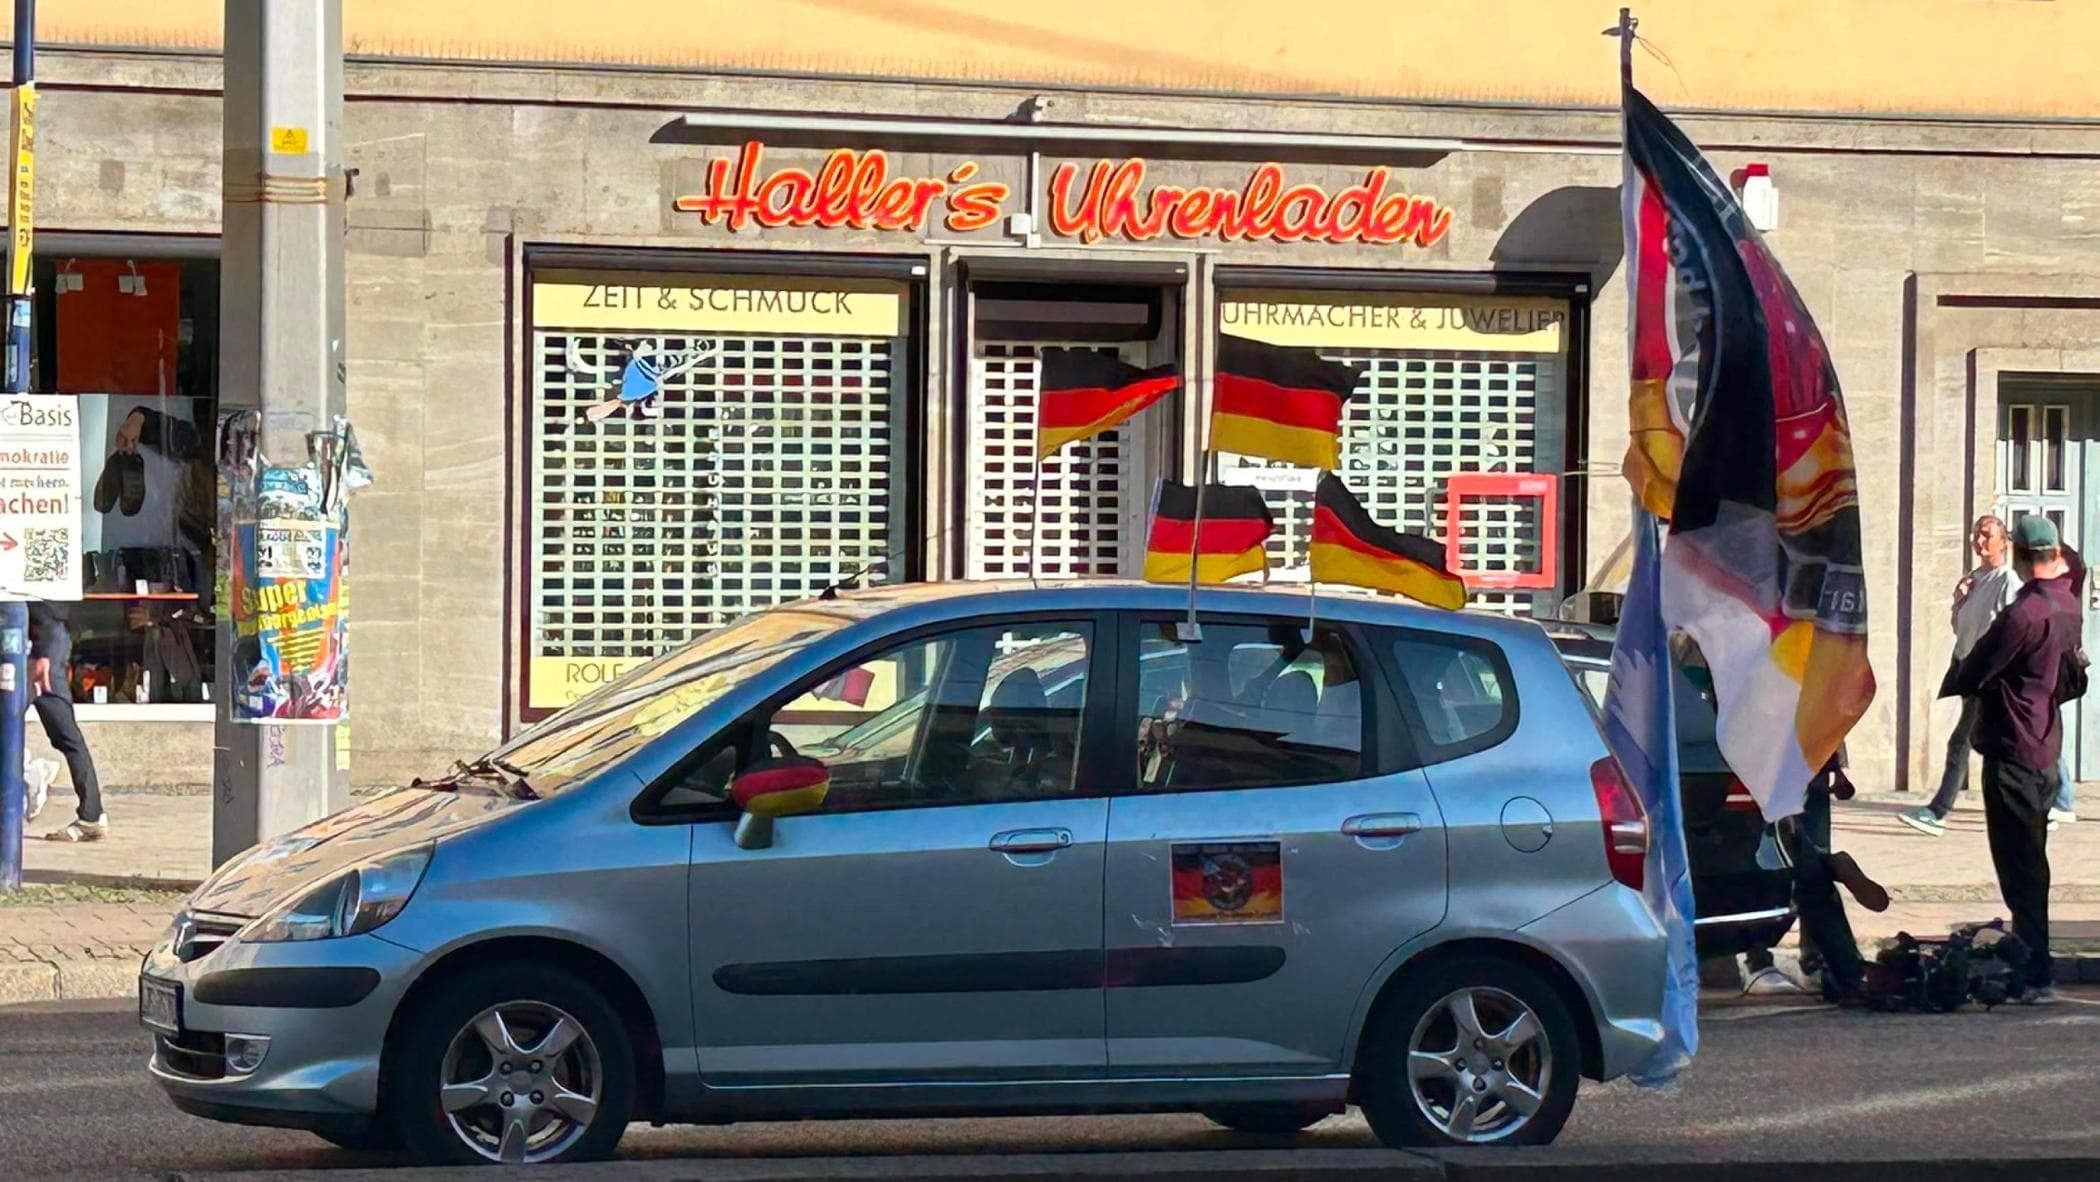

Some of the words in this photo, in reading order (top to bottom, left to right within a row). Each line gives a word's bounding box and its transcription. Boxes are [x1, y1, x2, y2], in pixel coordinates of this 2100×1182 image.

[676, 140, 1010, 231] Haller's
[1051, 156, 1455, 247] Uhrenladen
[583, 284, 644, 309] ZEIT
[657, 286, 677, 310] &
[689, 287, 852, 315] SCHMUCK
[1222, 302, 1401, 329] UHRMACHER
[1410, 306, 1427, 330] &
